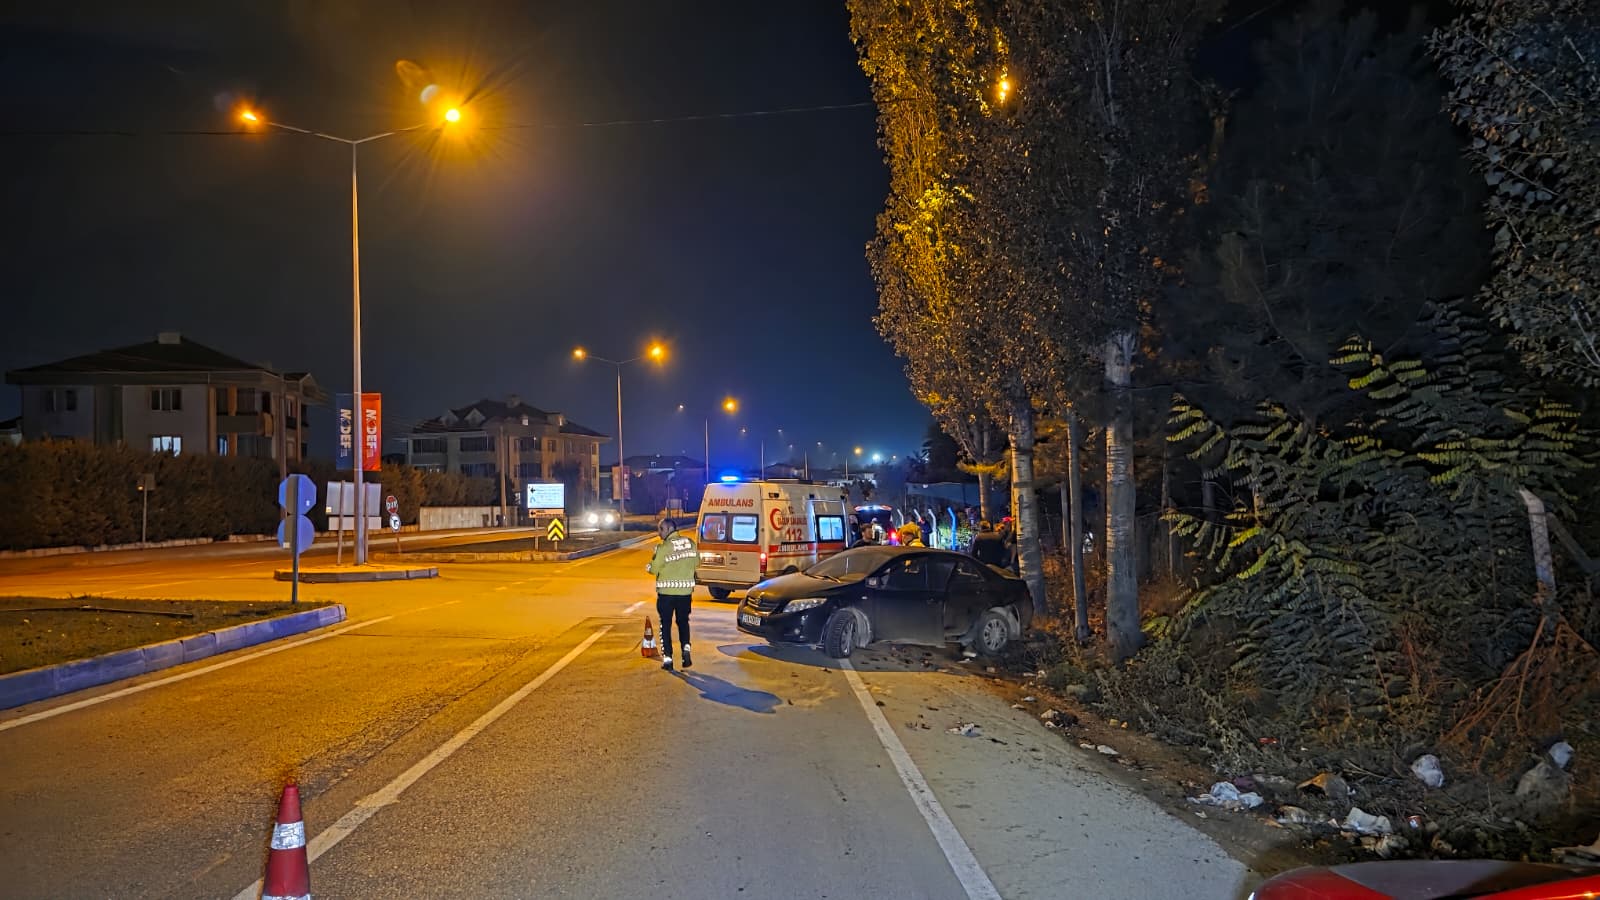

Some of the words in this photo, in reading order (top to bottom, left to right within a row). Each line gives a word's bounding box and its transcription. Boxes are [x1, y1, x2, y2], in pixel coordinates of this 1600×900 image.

[708, 499, 754, 507] AMBULANS
[786, 528, 802, 541] 112
[777, 544, 809, 553] AMBULANS
